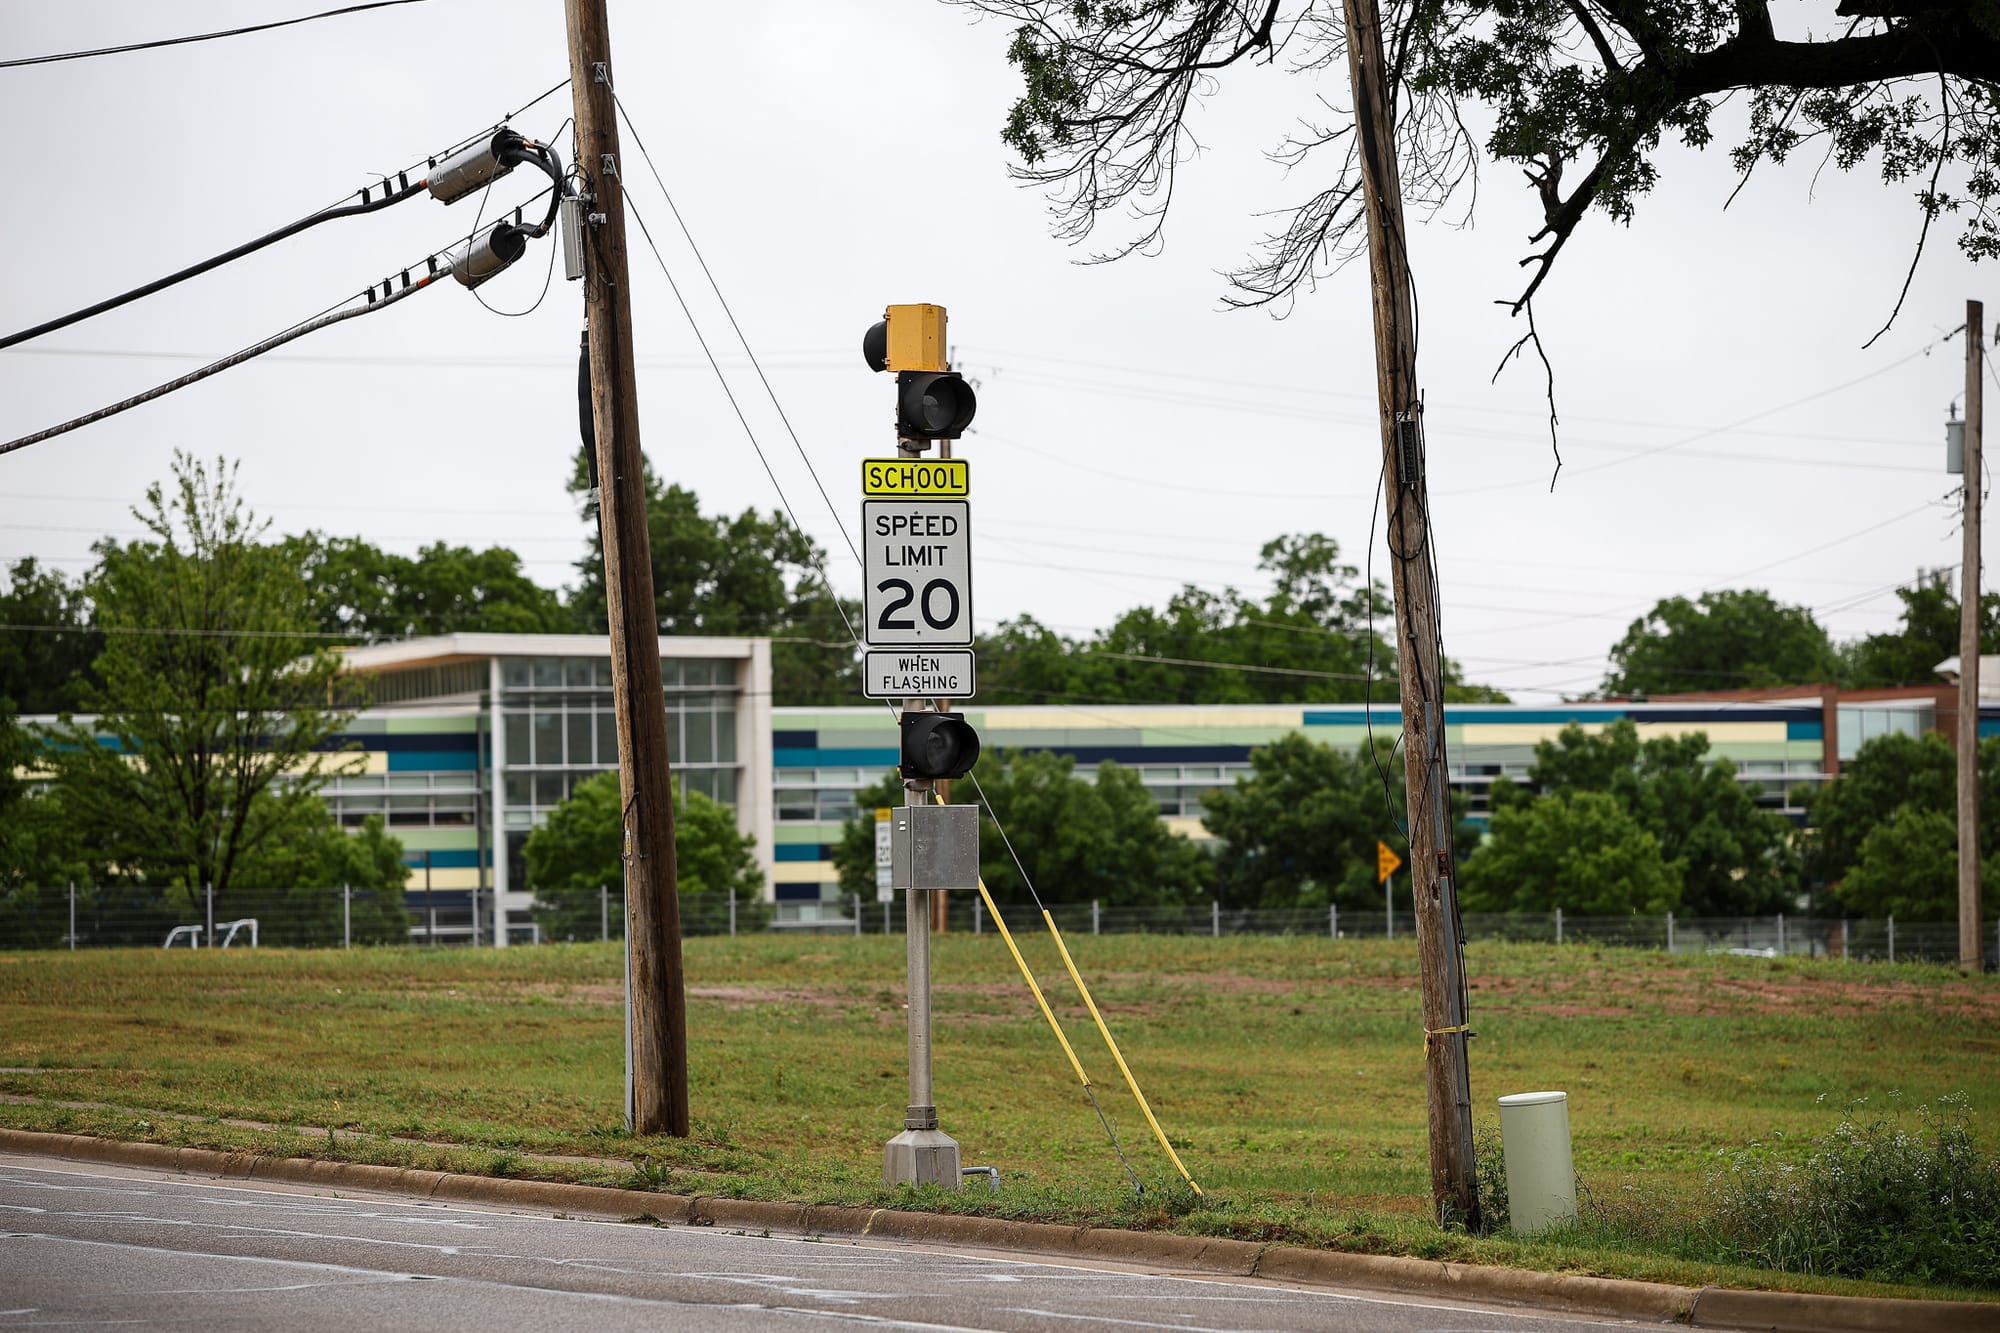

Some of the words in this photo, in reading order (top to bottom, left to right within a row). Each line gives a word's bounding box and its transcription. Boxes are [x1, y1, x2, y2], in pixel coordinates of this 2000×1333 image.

[870, 467, 962, 489] SCHOOL
[875, 515, 958, 536] SPEED
[885, 545, 948, 566] LIMIT
[876, 578, 960, 631] 20
[898, 658, 940, 672] WHEN
[883, 676, 958, 689] FLASHING
